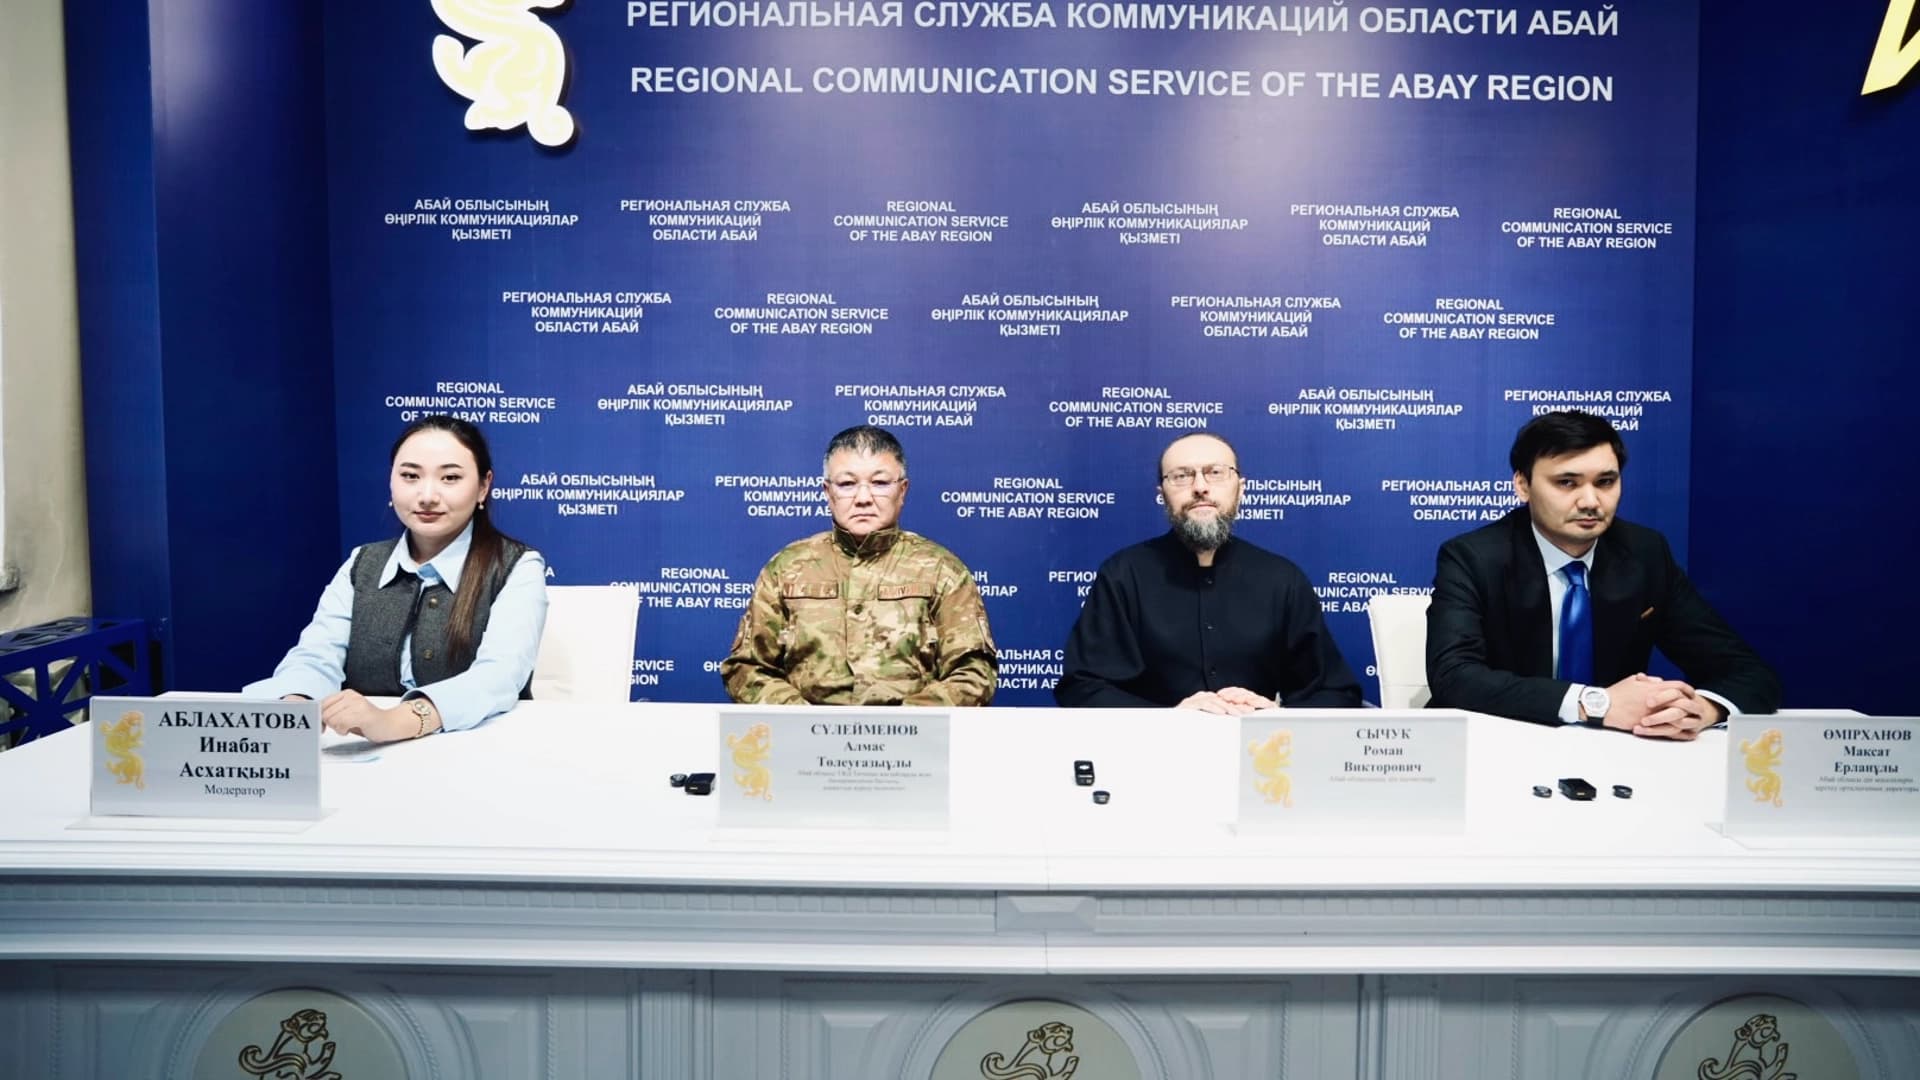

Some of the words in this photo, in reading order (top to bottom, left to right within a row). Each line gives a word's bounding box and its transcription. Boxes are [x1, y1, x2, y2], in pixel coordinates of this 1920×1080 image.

[627, 1, 901, 28] РЕГИОНАЛЬНАЯ
[914, 2, 1057, 29] СЛУЖБА
[1067, 0, 1349, 36] КОММУНИКАЦИЙ
[1359, 7, 1518, 35] ОБЛАСТИ
[1527, 4, 1620, 36] АБАЙ
[631, 67, 803, 94] REGIONAL
[812, 67, 1098, 95] COMMUNICATION
[1108, 69, 1251, 97] SERVICE
[1261, 71, 1305, 98] OF
[1316, 72, 1380, 99] THE
[1388, 73, 1478, 100] ABAY
[1487, 74, 1614, 102] REGION
[414, 196, 451, 210] АБАЙ
[454, 200, 549, 212] ОБЛЫСЫНЫҢ
[620, 200, 730, 211] РЕГИОНАЛЬНАЯ
[734, 200, 790, 211] СЛУЖБА
[887, 201, 956, 212] REGIONAL
[1081, 200, 1119, 214] АБАЙ
[1123, 203, 1218, 216] ОБЛЫСЫНЫҢ
[1291, 204, 1400, 217] РЕГИОНАЛЬНАЯ
[1404, 205, 1459, 217] СЛУЖБА
[649, 212, 761, 227] КОММУНИКАЦИЙ
[1554, 208, 1622, 219] REGIONAL
[384, 214, 437, 226] ӨҢІРЛІК
[440, 214, 578, 227] КОММУНИКАЦИЯЛАР
[834, 216, 947, 226] COMMUNICATION
[951, 216, 1008, 227] SERVICE
[1051, 217, 1105, 230] ӨҢІРЛІК
[1108, 218, 1248, 230] КОММУНИКАЦИЯЛАР
[1320, 217, 1430, 233] КОММУНИКАЦИЙ
[652, 229, 716, 240] ОБЛАСТИ
[720, 227, 757, 240] АБАЙ
[1502, 222, 1612, 233] COMMUNICATION
[1616, 223, 1672, 234] SERVICE
[452, 229, 511, 241] ҚЫЗМЕТІ
[849, 230, 868, 241] OF
[872, 230, 898, 241] THE
[900, 230, 937, 241] ABAY
[940, 230, 992, 242] REGION
[1120, 232, 1180, 245] ҚЫЗМЕТІ
[1323, 234, 1386, 246] ОБЛАСТИ
[1389, 232, 1426, 246] АБАЙ
[1517, 236, 1534, 247] OF
[1540, 236, 1564, 248] THE
[1567, 237, 1602, 248] ABAY
[1606, 237, 1656, 248] REGION
[503, 292, 612, 303] РЕГИОНАЛЬНАЯ
[615, 292, 672, 304] СЛУЖБА
[767, 293, 836, 304] REGIONAL
[962, 292, 999, 306] АБАЙ
[1002, 295, 1099, 308] ОБЛЫСЫНЫҢ
[1171, 296, 1281, 308] РЕГИОНАЛЬНАЯ
[1285, 297, 1341, 308] СЛУЖБА
[1436, 298, 1504, 310] REGIONAL
[531, 304, 643, 320] КОММУНИКАЦИЙ
[714, 308, 827, 319] COMMUNICATION
[831, 308, 888, 319] SERVICE
[931, 309, 985, 322] ӨҢІРЛІК
[988, 310, 1128, 323] КОММУНИКАЦИЯЛАР
[1200, 308, 1312, 324] КОММУНИКАЦИЙ
[1384, 313, 1495, 324] COMMUNICATION
[1498, 314, 1554, 325] SERVICE
[535, 321, 598, 332] ОБЛАСТИ
[601, 319, 639, 333] АБАЙ
[730, 322, 749, 334] OF
[752, 322, 778, 334] THE
[781, 323, 817, 334] ABAY
[820, 323, 872, 334] REGION
[1000, 324, 1060, 337] ҚЫЗМЕТІ
[1204, 326, 1268, 336] ОБЛАСТИ
[1270, 324, 1308, 337] АБАЙ
[1399, 327, 1417, 338] OF
[1420, 328, 1446, 339] THE
[1449, 328, 1485, 339] ABAY
[1488, 328, 1539, 339] REGION
[436, 382, 504, 393] REGIONAL
[627, 382, 664, 395] АБАЙ
[668, 384, 763, 398] ОБЛЫСЫНЫҢ
[835, 385, 946, 396] РЕГИОНАЛЬНАЯ
[949, 386, 1006, 397] СЛУЖБА
[1102, 387, 1171, 398] REGIONAL
[1298, 386, 1336, 400] АБАЙ
[1339, 389, 1434, 402] ОБЛЫСЫНЫҢ
[385, 396, 496, 408] COMMUNICATION
[499, 397, 555, 409] SERVICE
[1504, 390, 1612, 402] РЕГИОНАЛЬНАЯ
[1616, 390, 1672, 402] СЛУЖБА
[598, 399, 650, 411] ӨҢІРЛІК
[653, 399, 793, 412] КОММУНИКАЦИЯЛАР
[864, 398, 977, 413] КОММУНИКАЦИЙ
[1049, 402, 1162, 413] COMMUNICATION
[1166, 402, 1223, 413] SERVICE
[1268, 403, 1321, 416] ӨҢІРЛІК
[1324, 404, 1463, 417] КОММУНИКАЦИЯЛАР
[401, 410, 418, 422] OF
[489, 412, 540, 423] REGION
[665, 414, 725, 426] ҚЫЗМЕТІ
[868, 414, 932, 426] ОБЛАСТИ
[935, 412, 973, 426] АБАЙ
[1065, 416, 1083, 427] OF
[1087, 416, 1113, 427] THE
[1116, 416, 1152, 427] ABAY
[1156, 417, 1207, 428] REGION
[1336, 418, 1396, 431] ҚЫЗМЕТІ
[1611, 418, 1639, 431] БАЙ
[520, 472, 558, 486] АБАЙ
[561, 474, 655, 488] ОБЛЫСЫНЫҢ
[715, 476, 824, 487] РЕГИОНАЛЬНАЯ
[994, 478, 1063, 489] REGIONAL
[1246, 479, 1322, 493] ЛЫСЫНЫҢ
[1382, 480, 1490, 492] РЕГИОНАЛЬНАЯ
[491, 488, 544, 502] ӨҢІРЛІК
[546, 489, 684, 502] КОММУНИКАЦИЯЛАР
[744, 491, 828, 502] КОММУНИКА
[941, 492, 1054, 503] COMMUNICATION
[1058, 492, 1115, 504] SERVICE
[1242, 494, 1352, 507] МУНИКАЦИЯЛАР
[558, 504, 618, 517] ҚЫЗМЕТІ
[747, 505, 811, 517] ОБЛАСТИ
[957, 506, 975, 517] OF
[979, 506, 1005, 518] THE
[1008, 507, 1044, 518] ABAY
[1047, 507, 1099, 518] REGION
[1236, 508, 1284, 520] ЫЗМЕТІ
[1413, 509, 1477, 521] ОБЛАСТИ
[1480, 508, 1509, 520] АБА
[661, 567, 729, 579] REGIONAL
[1329, 572, 1397, 584] REGIONAL
[646, 596, 673, 608] THE
[676, 597, 711, 608] ABAY
[1342, 601, 1369, 612] ABA
[158, 711, 311, 729] АБЛАХАТОВА
[1356, 728, 1412, 740] СЫЧУК
[200, 736, 271, 753] Инабат
[844, 741, 886, 752] Алмас
[1363, 745, 1403, 756] Роман
[179, 762, 290, 780] Асхатқызы
[1344, 761, 1422, 775] Викторович
[204, 784, 266, 797] Модератор
